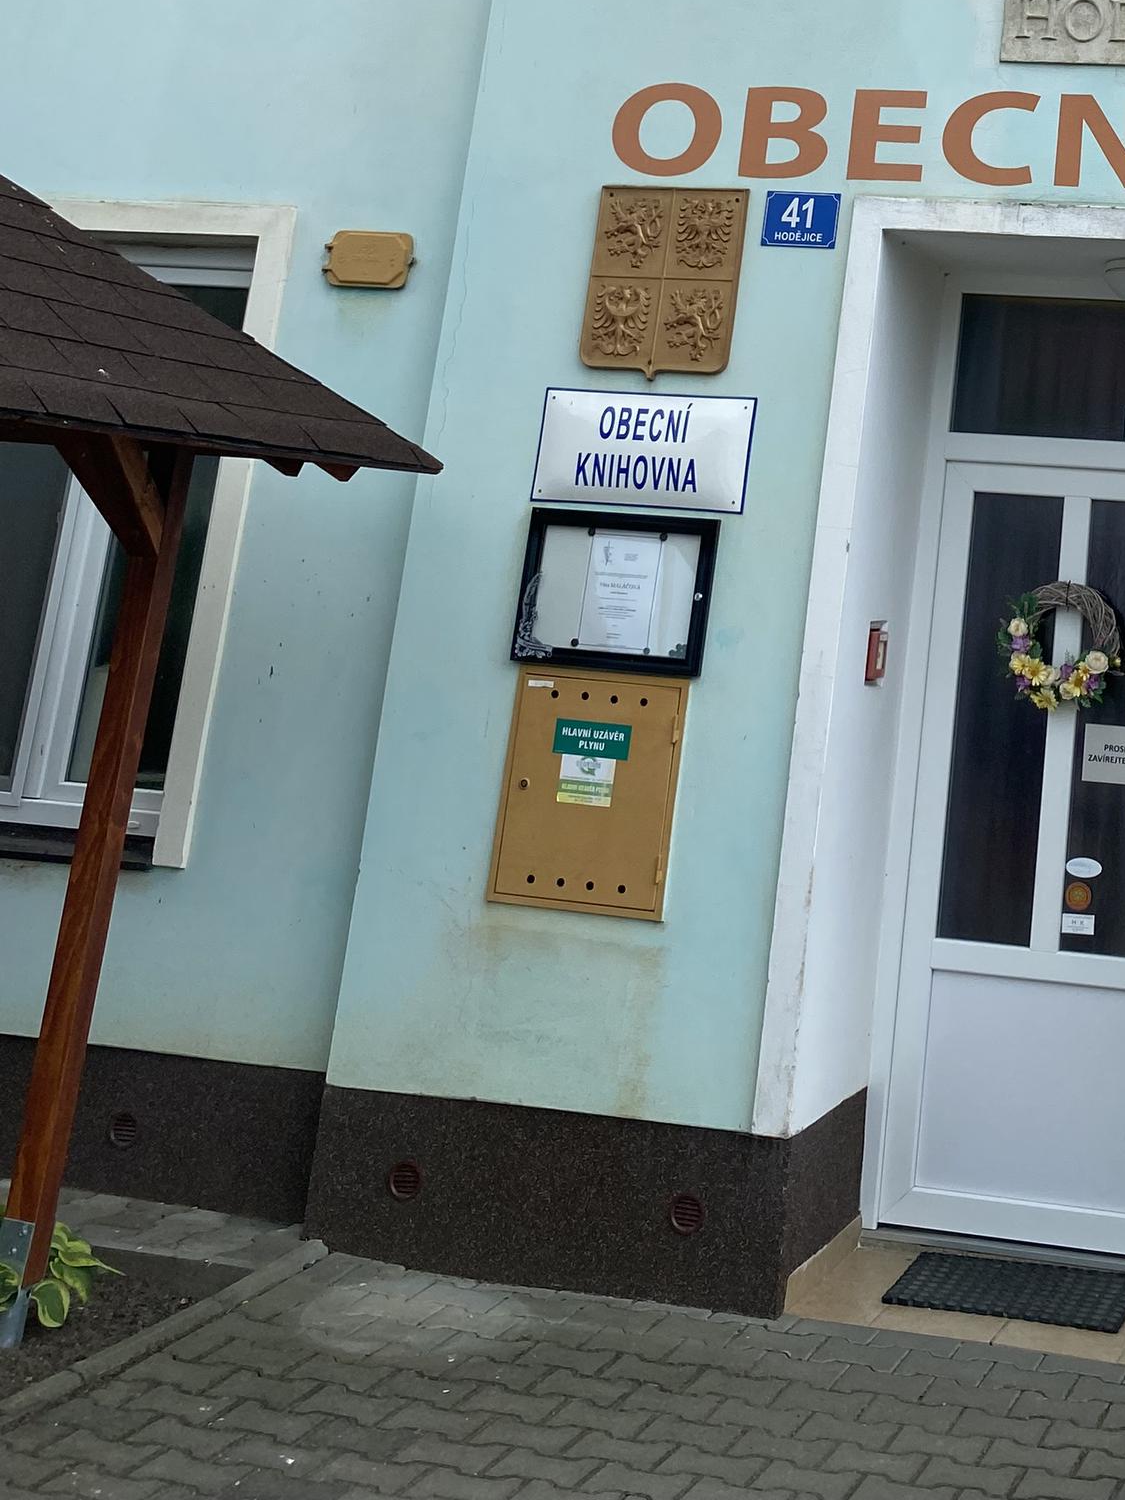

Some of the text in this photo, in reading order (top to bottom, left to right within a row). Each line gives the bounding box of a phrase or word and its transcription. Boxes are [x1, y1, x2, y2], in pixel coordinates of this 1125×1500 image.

[780, 197, 814, 228] 41
[773, 229, 823, 243] HODĚJICE
[599, 402, 693, 443] OBECNÍ
[574, 452, 697, 493] KNIHOVNA
[562, 727, 625, 741] HLAVNÍ UZÁVĚR
[578, 740, 605, 751] PLYNU
[1088, 754, 1125, 764] ZAVÍREJTE
